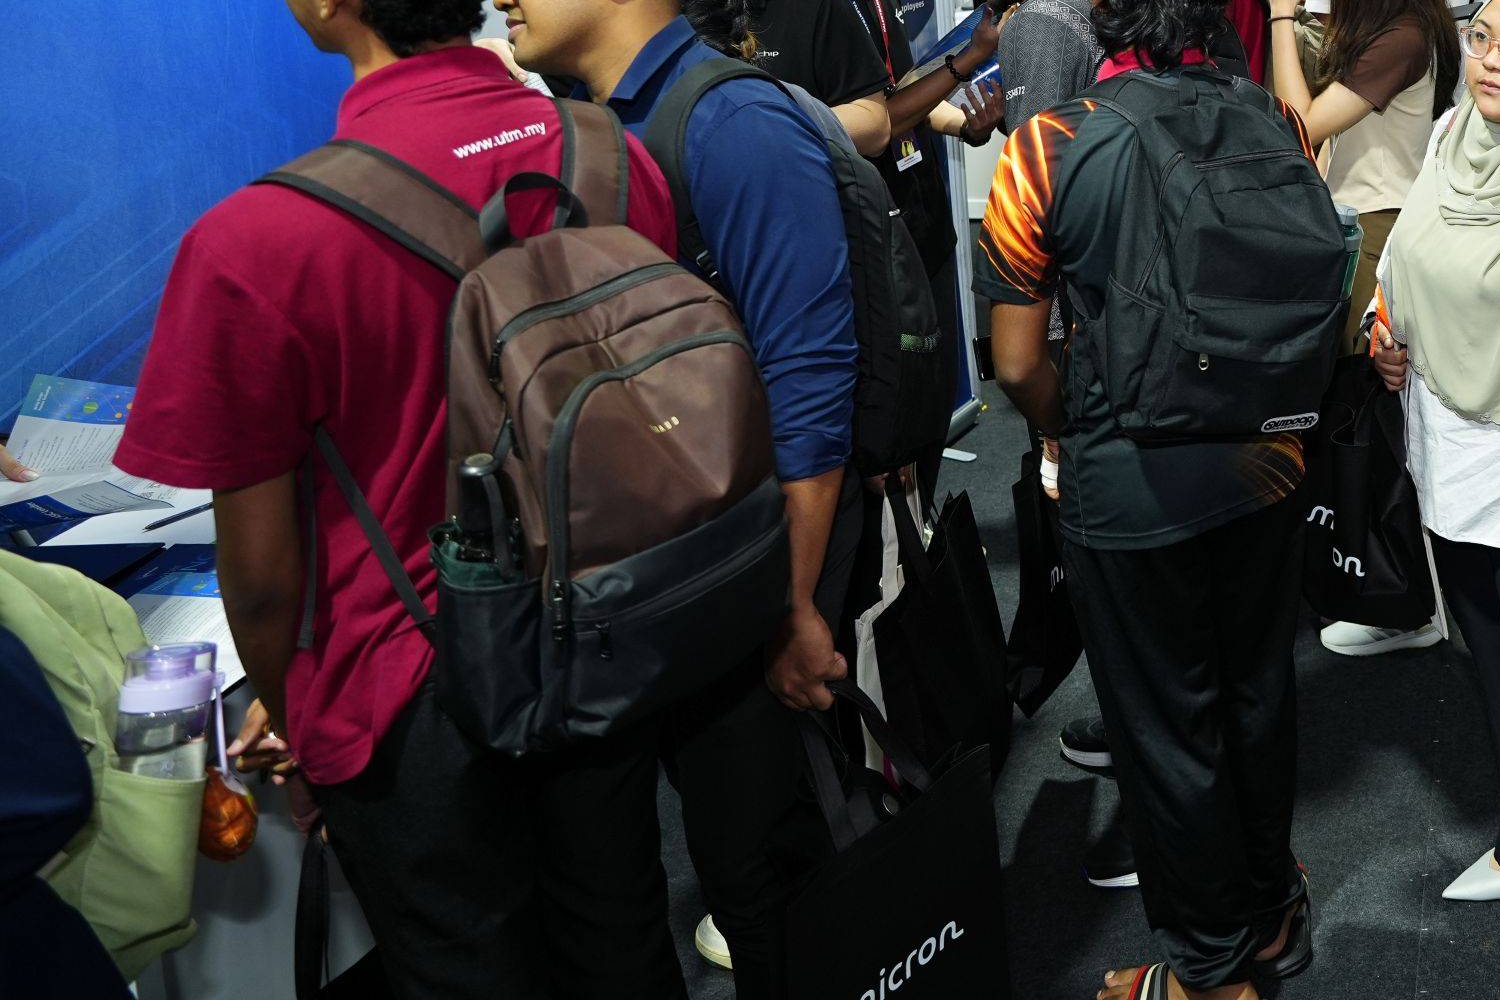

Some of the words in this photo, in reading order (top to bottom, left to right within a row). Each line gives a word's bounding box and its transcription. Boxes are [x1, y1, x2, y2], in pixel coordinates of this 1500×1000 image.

[901, 0, 925, 14] ployees
[452, 121, 546, 159] www.utm.my
[1263, 415, 1315, 431] OUTDOOR
